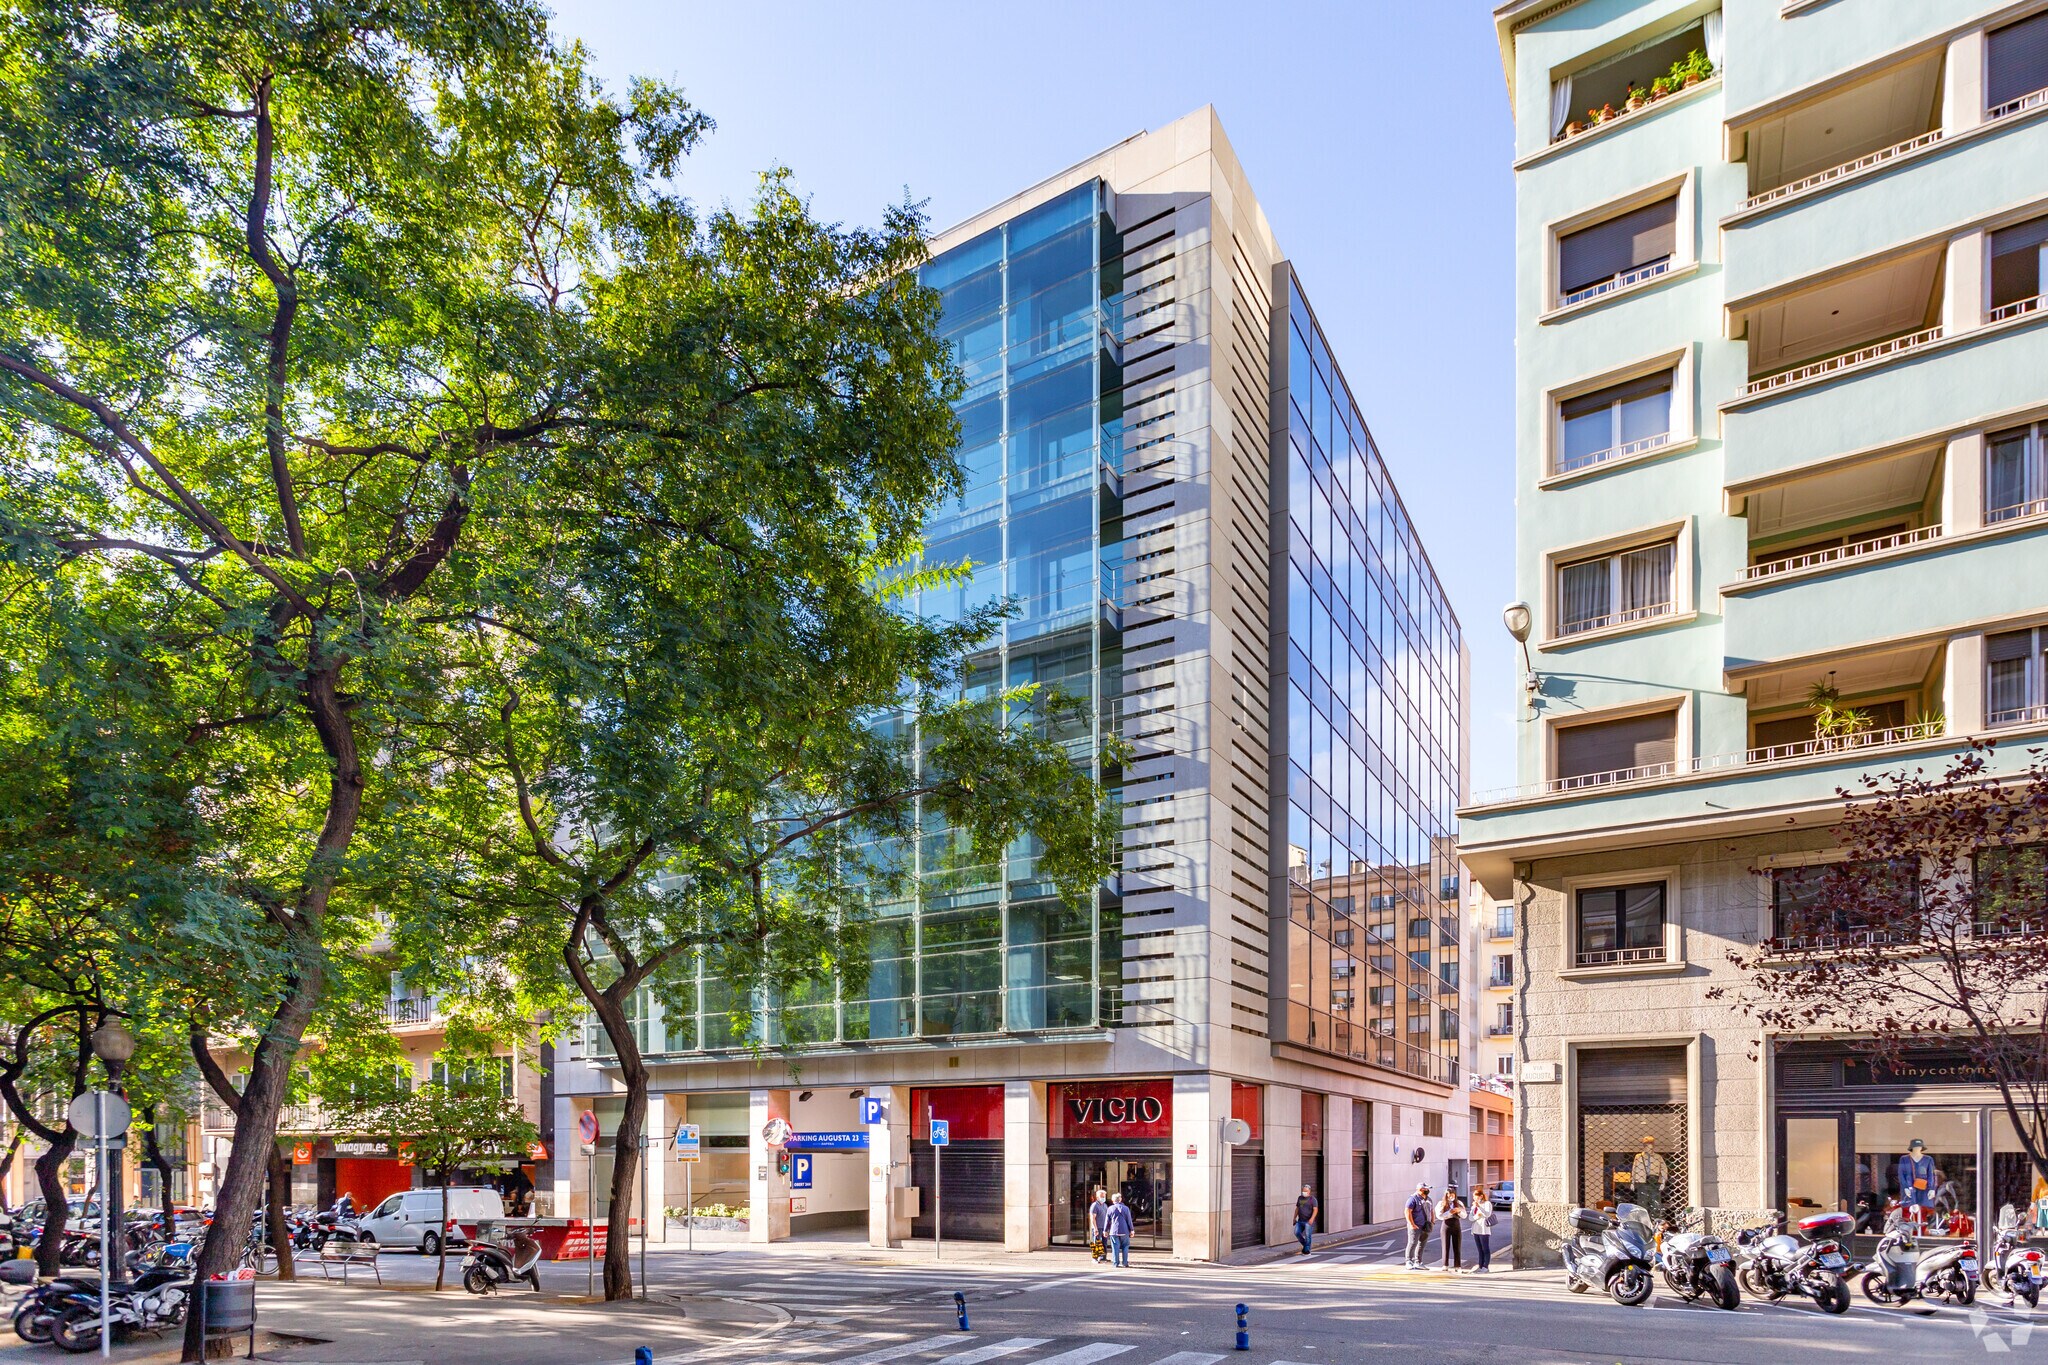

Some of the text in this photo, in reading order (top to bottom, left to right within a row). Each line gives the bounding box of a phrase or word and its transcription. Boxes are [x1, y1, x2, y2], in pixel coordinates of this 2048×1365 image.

[1895, 1066, 1997, 1077] tinycottons
[867, 1101, 879, 1121] P
[1068, 1096, 1163, 1124] VICIO
[335, 1142, 389, 1155] vivagym.es
[797, 1158, 809, 1180] P
